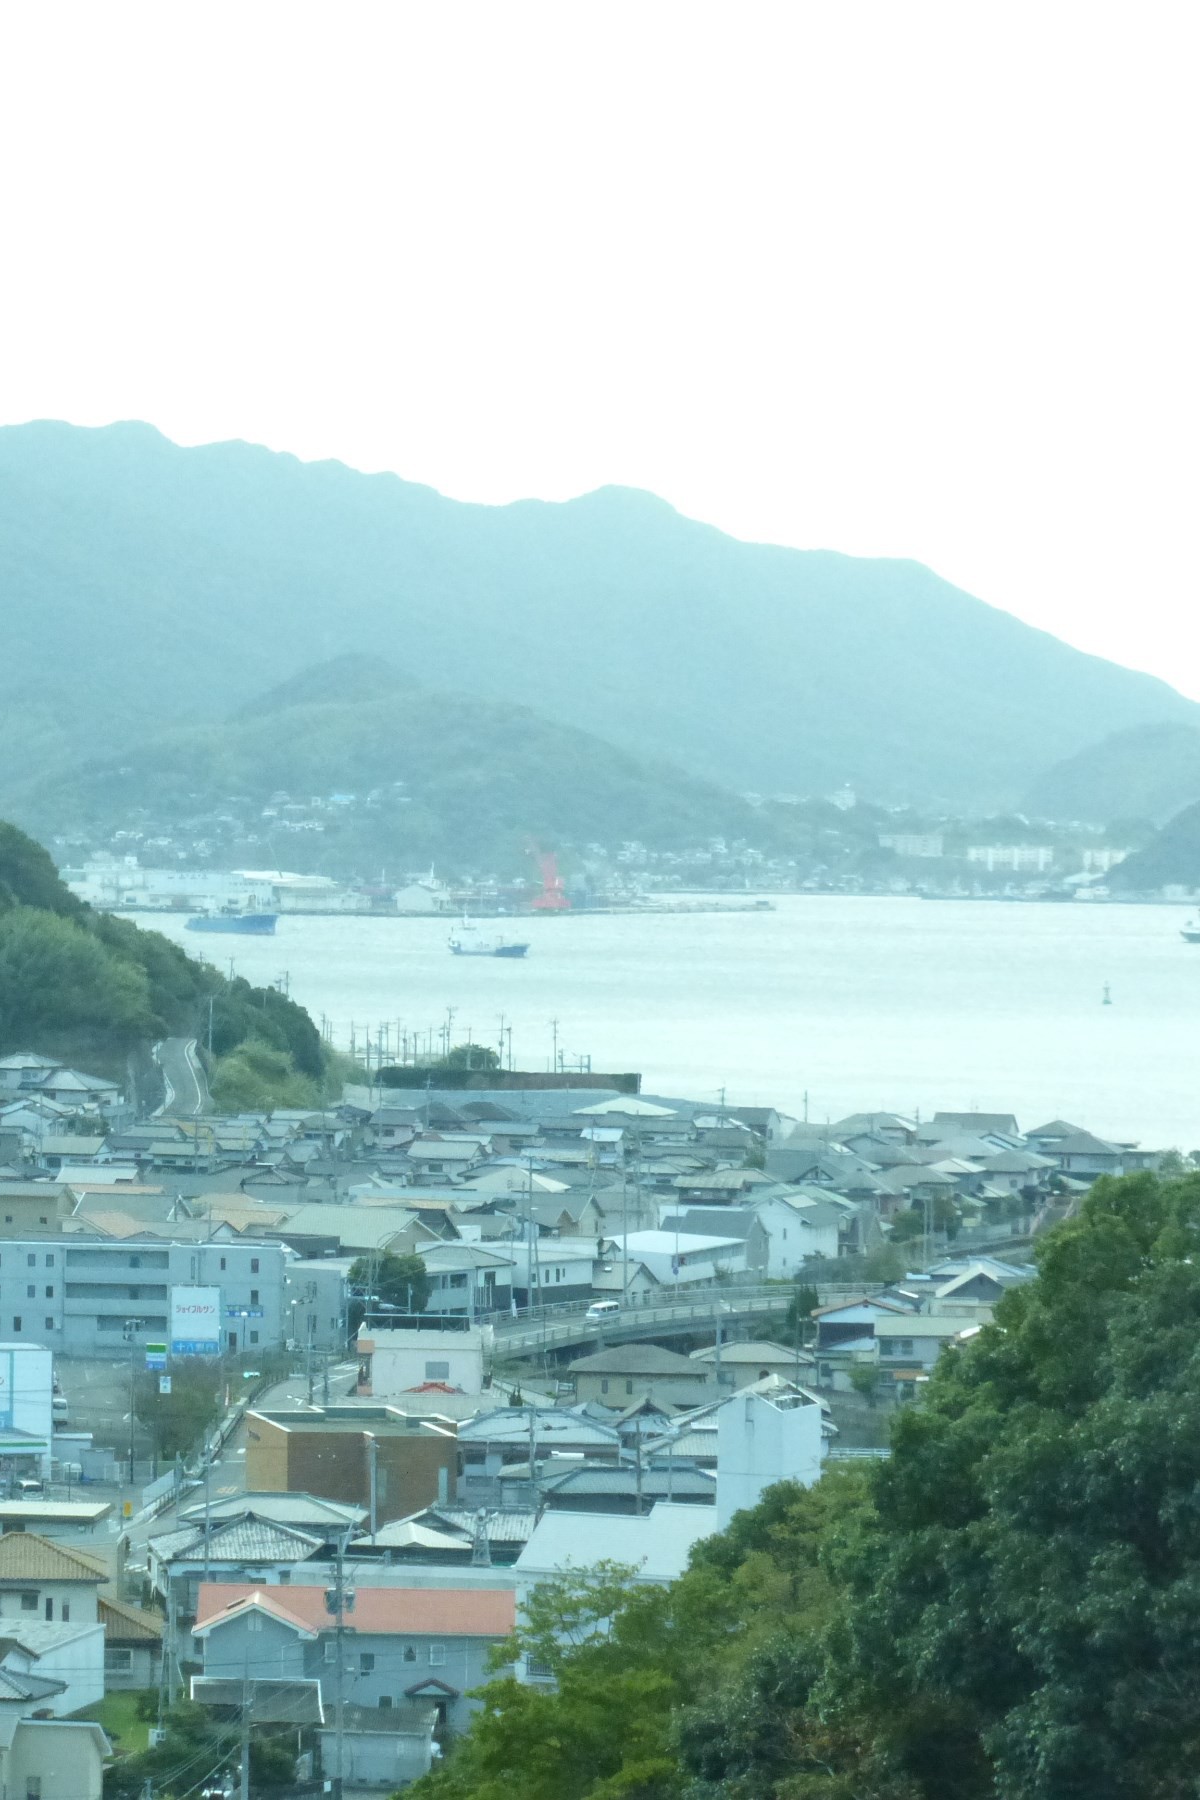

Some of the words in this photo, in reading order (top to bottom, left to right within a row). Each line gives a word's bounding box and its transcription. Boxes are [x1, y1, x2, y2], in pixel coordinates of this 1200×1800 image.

[175, 1304, 216, 1314] ジョイフルサン
